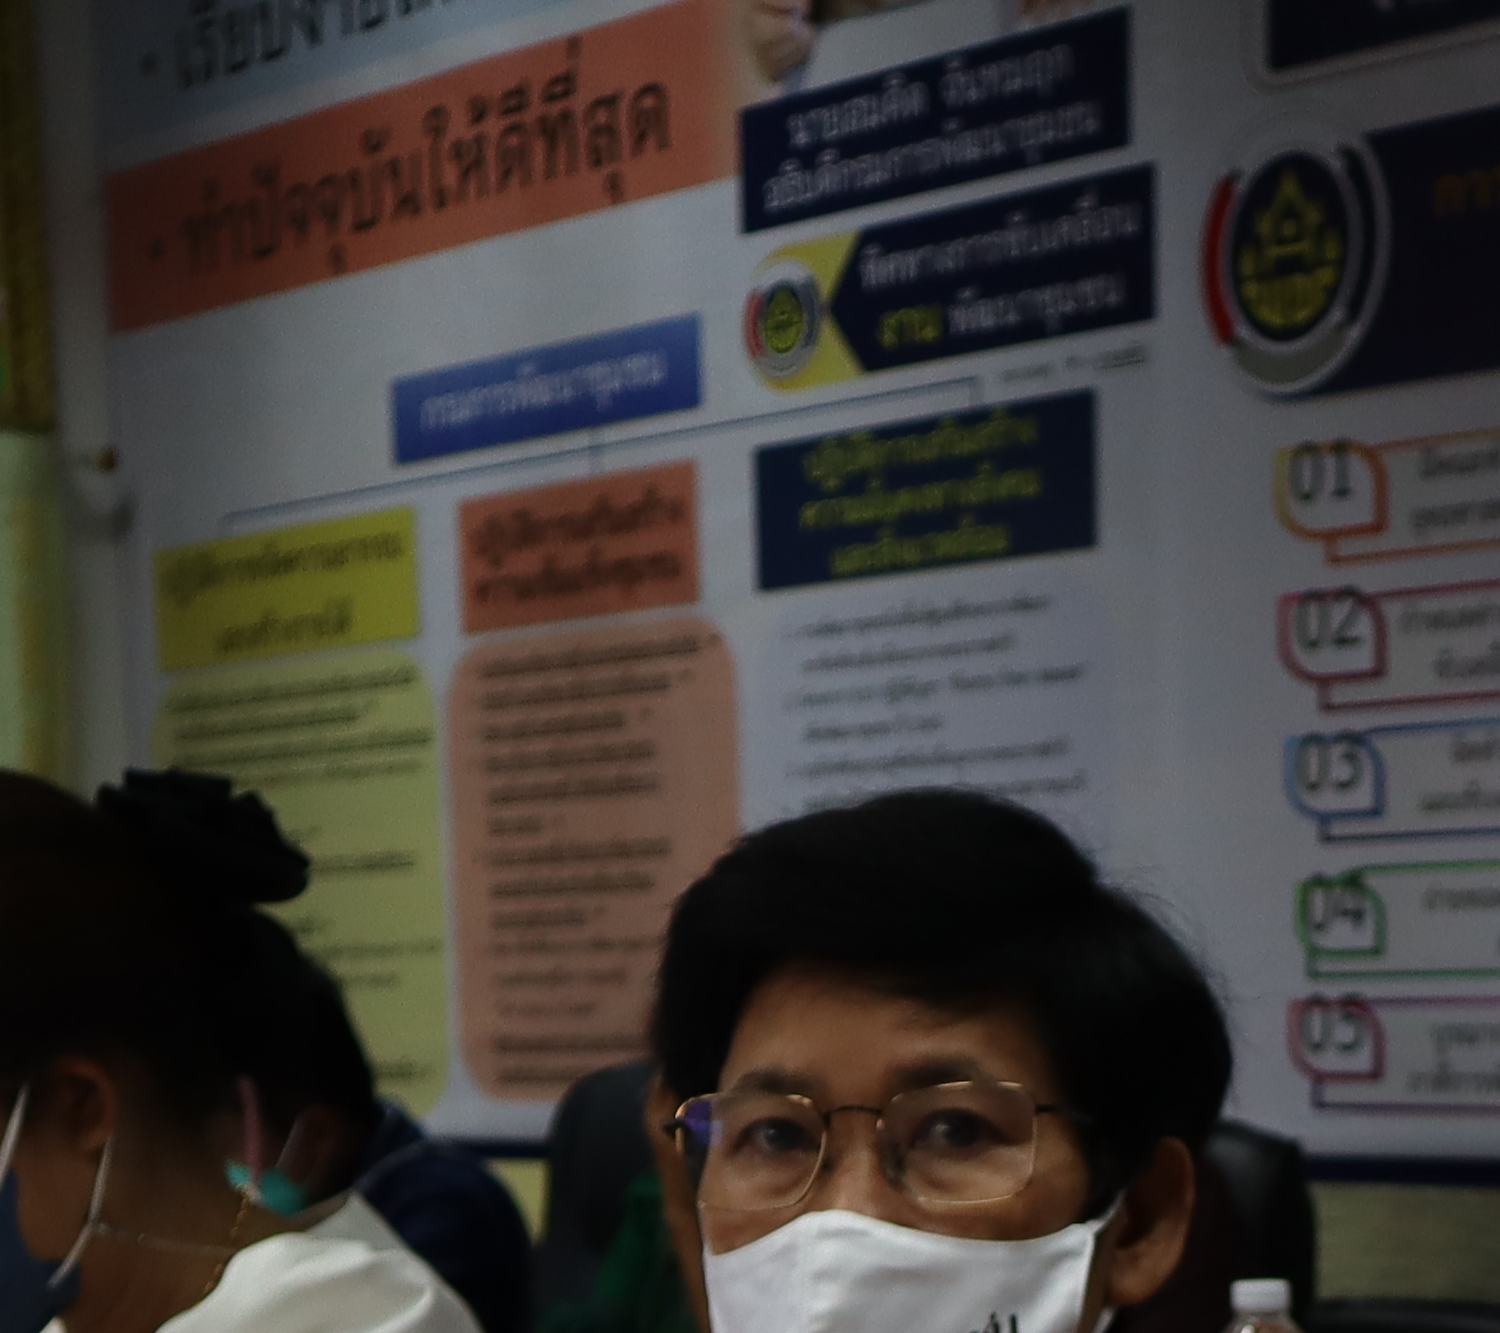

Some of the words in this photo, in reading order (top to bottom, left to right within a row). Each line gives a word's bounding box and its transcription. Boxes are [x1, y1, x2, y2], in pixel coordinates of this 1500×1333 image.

[179, 36, 674, 275] ทำปัจจุบันให้ดีที่สุด
[1289, 439, 1352, 504] 01
[1298, 586, 1362, 651] 02
[1305, 730, 1364, 793] 03
[1304, 874, 1367, 932] 04
[1304, 993, 1365, 1052] 05
